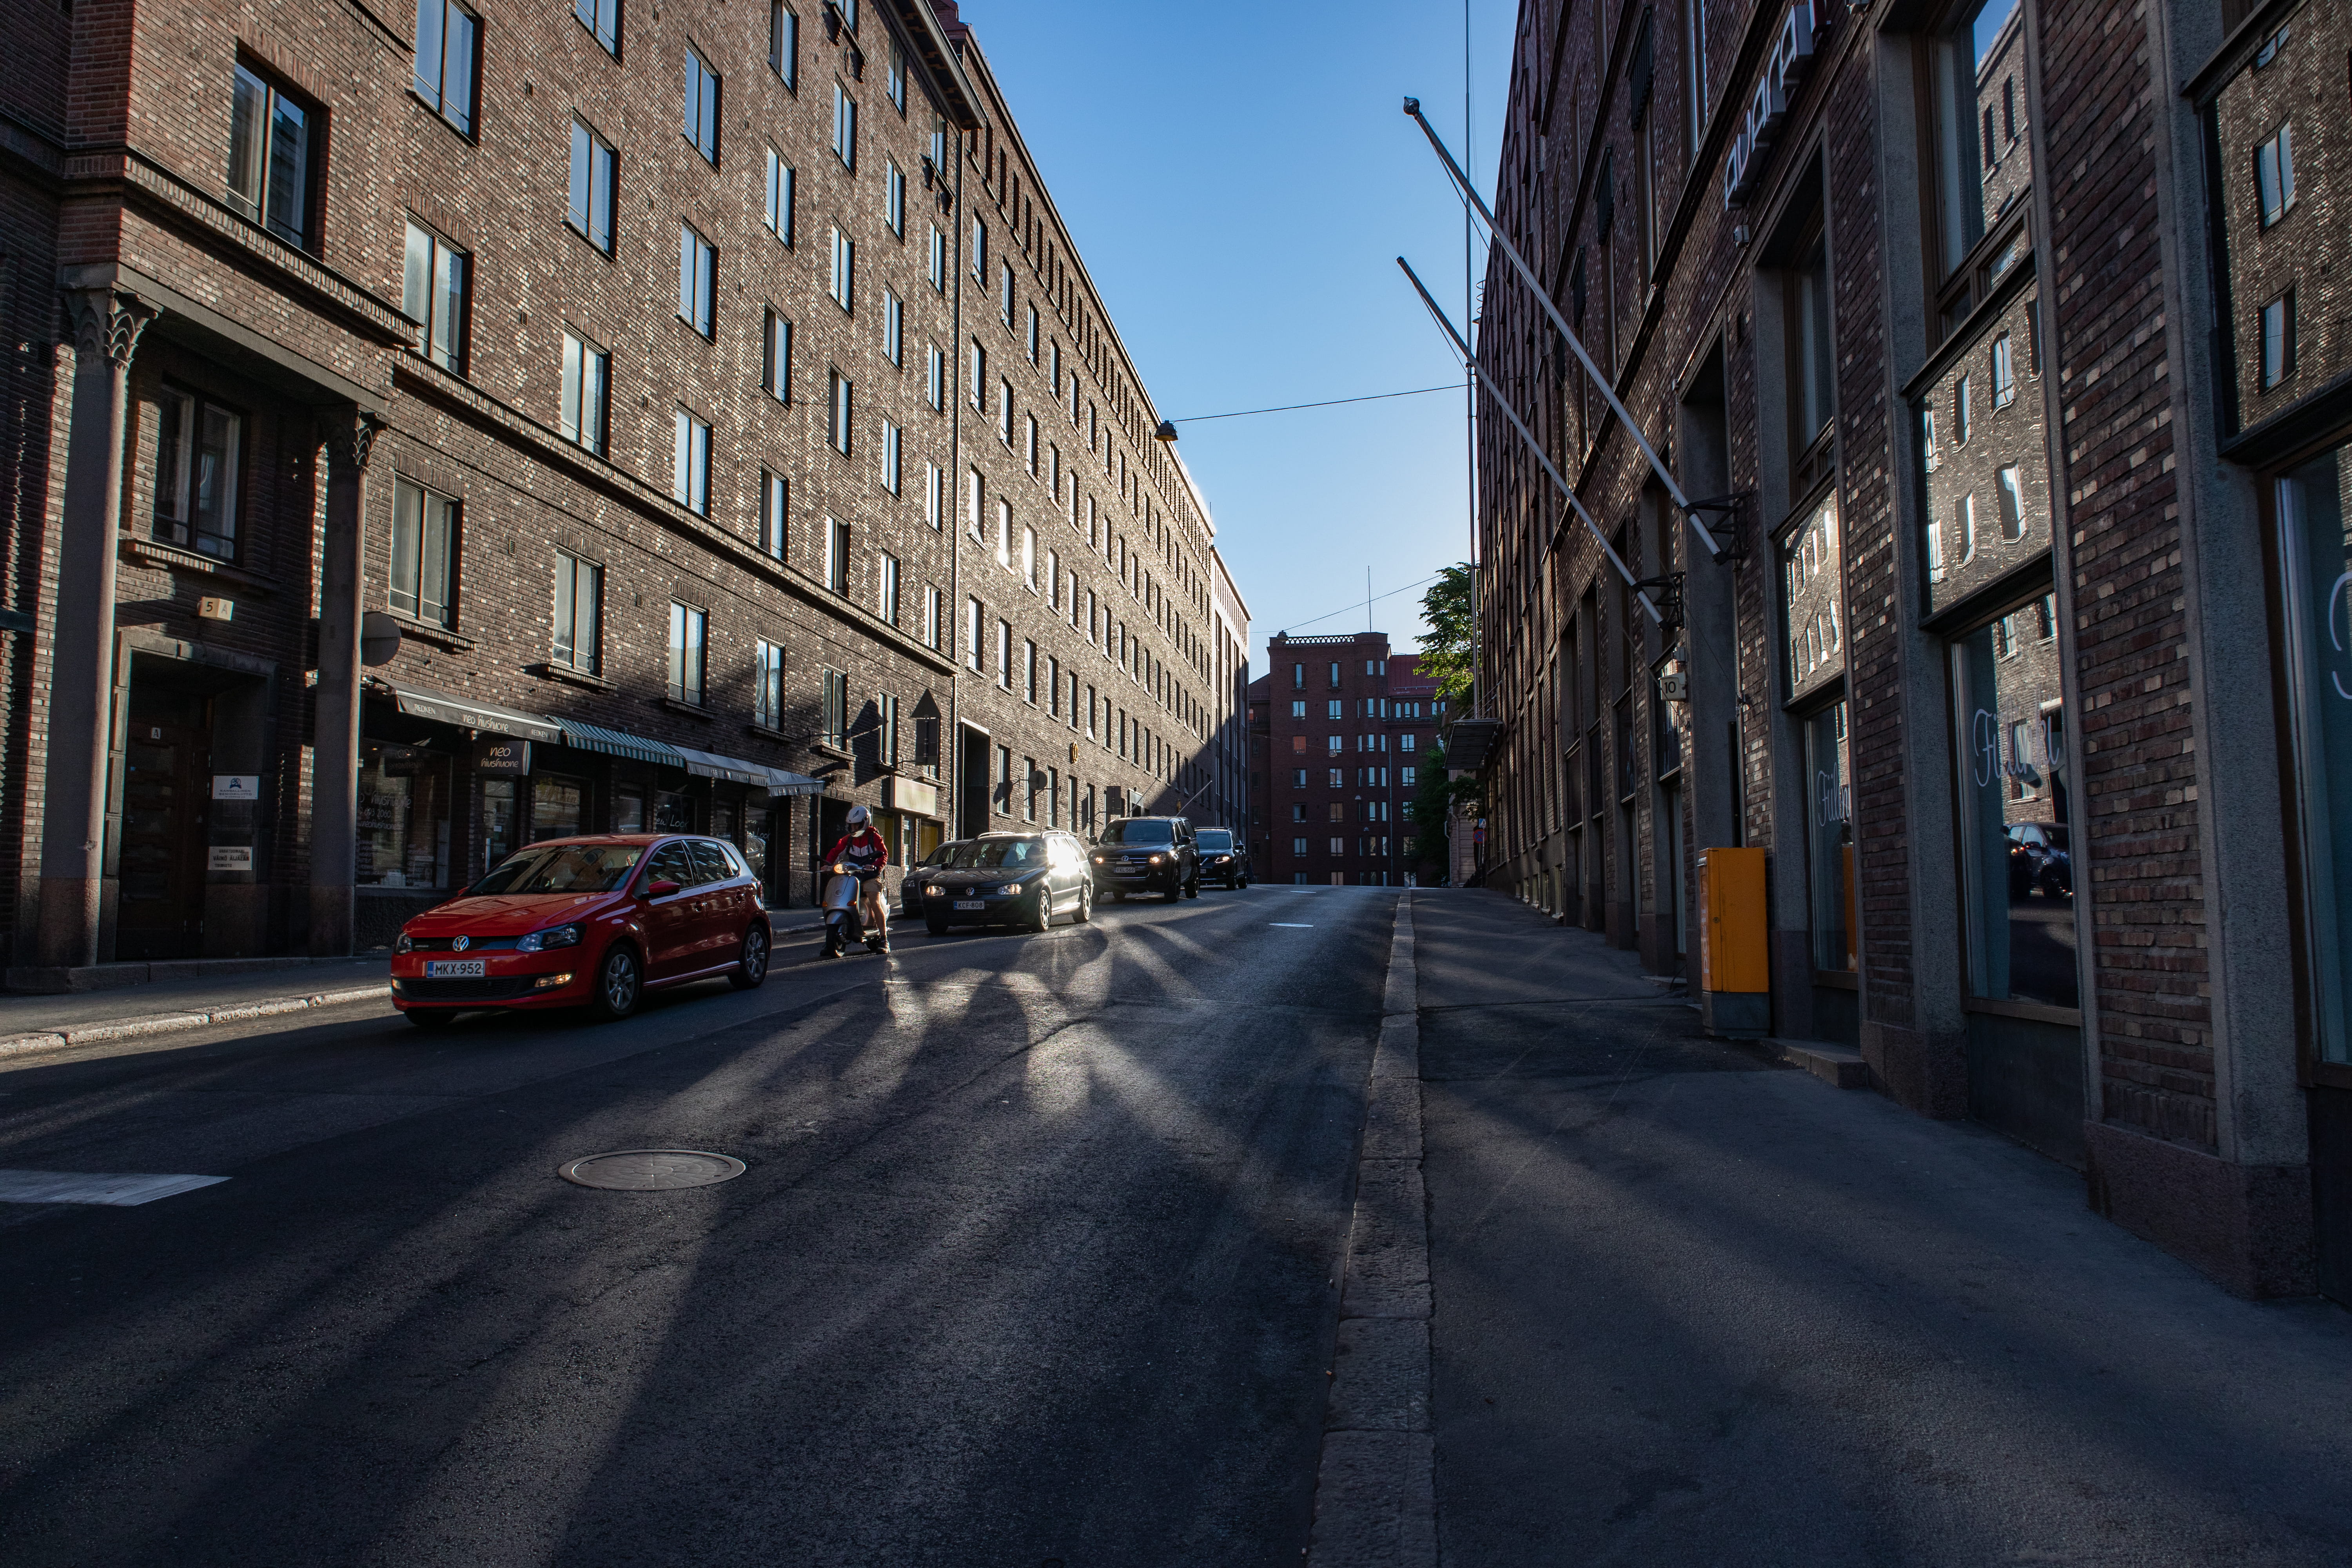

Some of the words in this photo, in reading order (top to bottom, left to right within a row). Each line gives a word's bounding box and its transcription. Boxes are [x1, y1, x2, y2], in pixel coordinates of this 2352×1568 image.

[1725, 4, 1798, 211] avara
[206, 601, 213, 612] 5
[221, 604, 228, 615] A
[1664, 681, 1676, 693] 10
[414, 704, 436, 714] REDKEN
[463, 714, 475, 724] neo
[478, 715, 509, 732] hiushuone
[153, 729, 159, 737] A
[531, 729, 548, 738] REDKEN
[490, 747, 511, 757] neo
[481, 757, 519, 768] hiushuone
[435, 964, 481, 975] MKX-952
